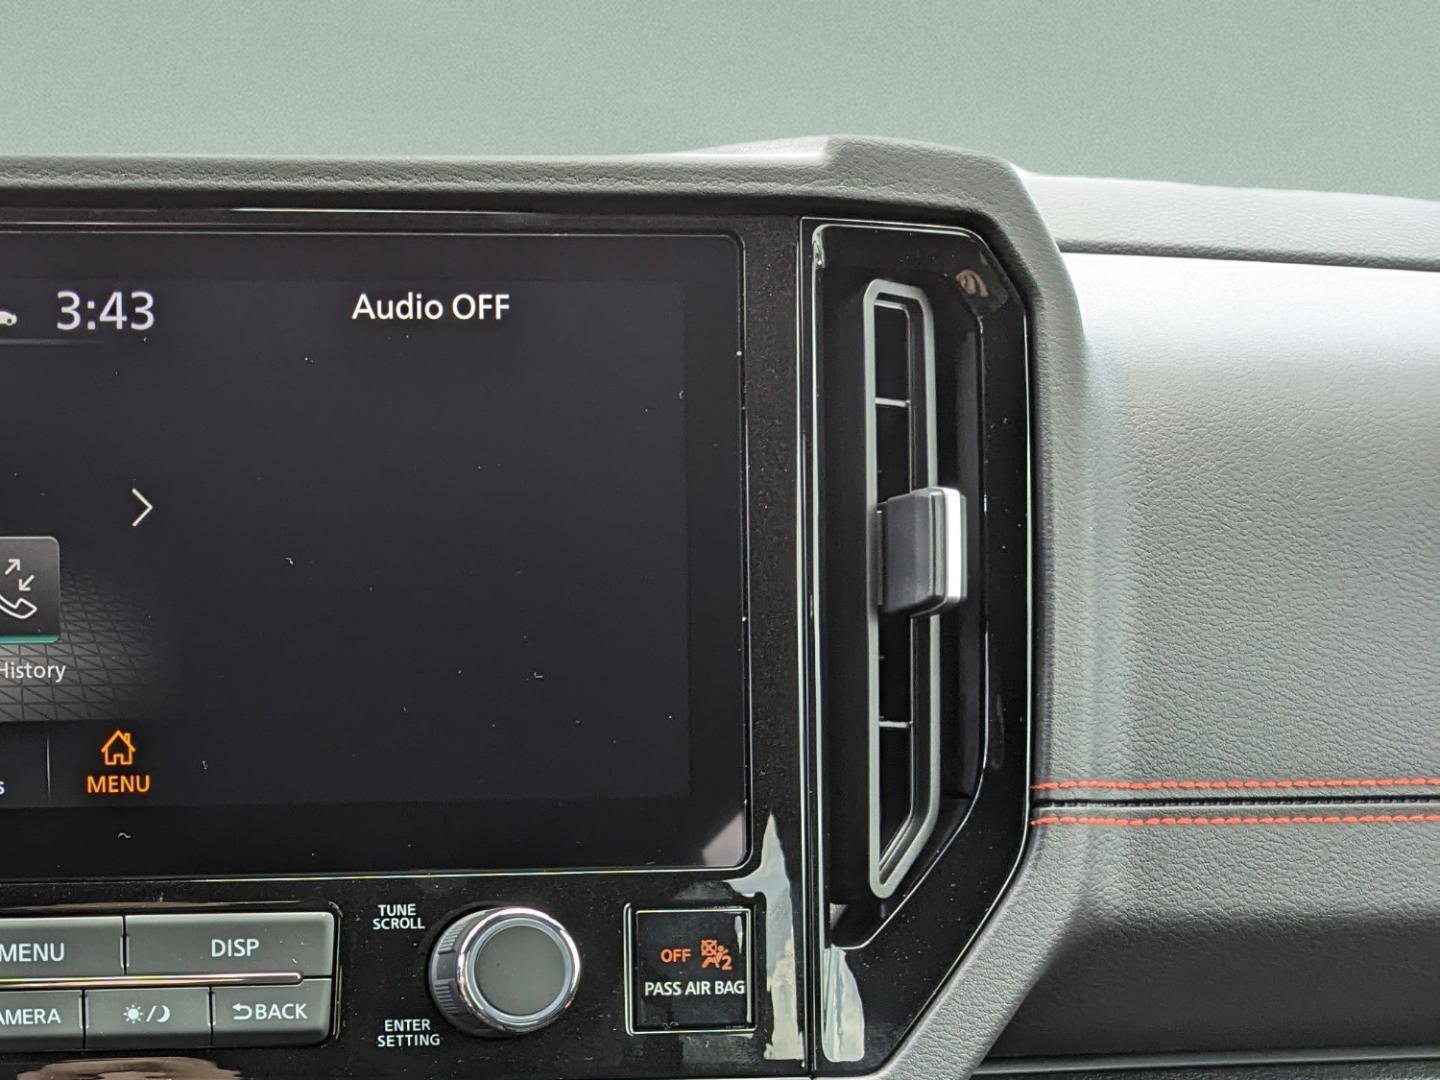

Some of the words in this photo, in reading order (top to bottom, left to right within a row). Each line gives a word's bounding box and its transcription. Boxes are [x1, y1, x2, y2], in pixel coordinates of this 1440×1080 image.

[55, 290, 156, 332] 3:43
[351, 293, 444, 320] Audio
[451, 293, 510, 320] OFF
[86, 774, 151, 794] MENU
[378, 904, 416, 917] TUNE
[372, 917, 426, 930] SCROLL
[211, 938, 259, 958] DISP
[660, 948, 692, 963] OFF
[644, 981, 682, 996] PASS
[684, 980, 711, 995] AIR
[715, 980, 745, 995] BAG
[255, 1003, 308, 1021] BACK
[384, 1019, 431, 1032] ENTER
[377, 1033, 441, 1047] SETTING
